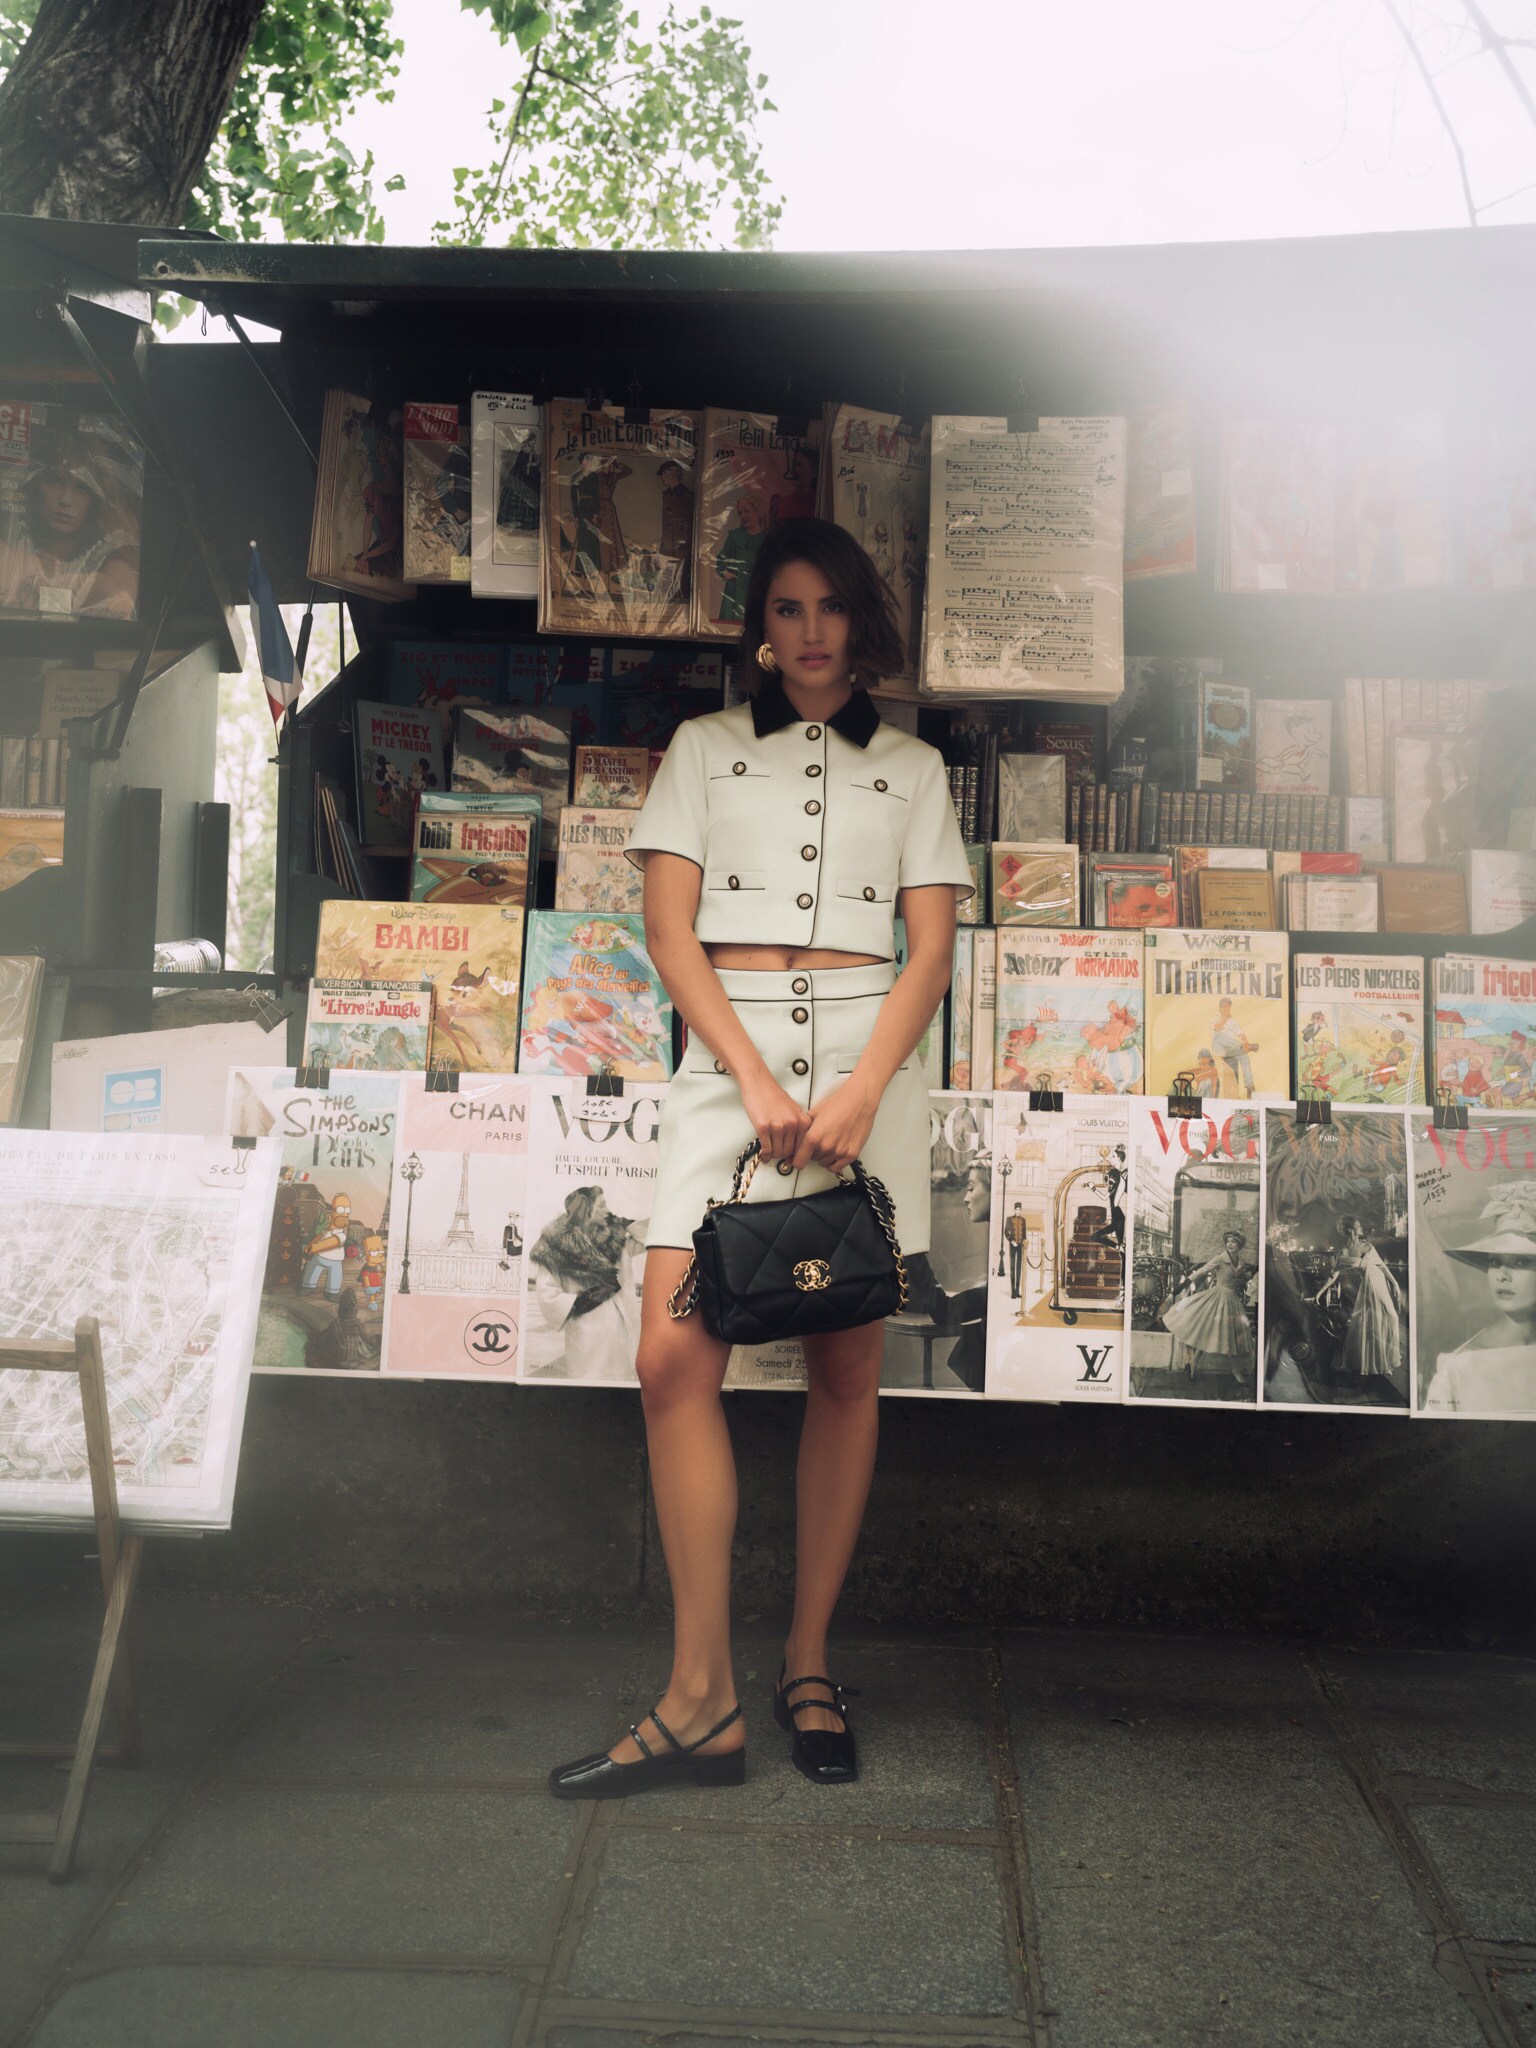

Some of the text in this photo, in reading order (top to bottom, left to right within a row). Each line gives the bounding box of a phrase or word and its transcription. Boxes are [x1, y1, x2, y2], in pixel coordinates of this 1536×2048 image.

[581, 411, 611, 447] Petit
[739, 419, 764, 449] Petit
[400, 652, 427, 664] ZIG
[431, 653, 449, 664] ET
[370, 718, 430, 741] MICKEY
[371, 737, 383, 747] ET
[384, 737, 396, 748] LE
[1046, 734, 1086, 750] Sexus
[582, 765, 641, 777] DES CASTORS
[465, 805, 494, 813] TINTIN
[419, 821, 527, 852] bibi fricotin
[570, 824, 626, 846] LES PIEDS
[1222, 910, 1268, 918] FONDEMENT
[374, 923, 470, 952] BAMBI
[1182, 934, 1252, 952] WINCH
[568, 953, 630, 980] Alice au
[1003, 952, 1070, 977] Astérix
[1074, 957, 1140, 979] NORMANDS
[1191, 958, 1256, 972] LA FORTERESSE DE
[323, 979, 423, 991] VERSION FRANÇAISE
[547, 976, 651, 993] Pays des Merveilles
[1154, 959, 1285, 999] MAKILING
[1299, 966, 1321, 988] LES
[1324, 966, 1361, 989] PIEDS
[1439, 962, 1475, 996] bibi
[344, 990, 373, 998] DISNEY
[1354, 990, 1421, 1001] FOOTBALLEURS
[320, 998, 328, 1008] le
[326, 998, 365, 1016] Livre
[366, 999, 375, 1008] de
[375, 1000, 421, 1020] Jungle
[137, 1114, 158, 1124] VISA
[283, 1097, 395, 1138] SIMPSONS
[449, 1101, 526, 1123] CHAN
[1077, 1117, 1130, 1129] LOUIS VUITTON
[485, 1131, 523, 1142] PARIS
[1149, 1109, 1257, 1162] VOG
[1189, 1131, 1210, 1139] PARIS
[1318, 1134, 1340, 1143] PARIS
[57, 1151, 74, 1161] DE
[312, 1134, 377, 1169] Paris
[555, 1154, 622, 1165] HAUTE COUTURE
[208, 1164, 220, 1175] 5
[555, 1164, 610, 1177] L'ESPRIT
[1209, 1168, 1254, 1181] LOUVRE
[1414, 1166, 1443, 1180] AUDREY
[1417, 1172, 1453, 1190] HEPBURN
[755, 1357, 793, 1369] Samedi
